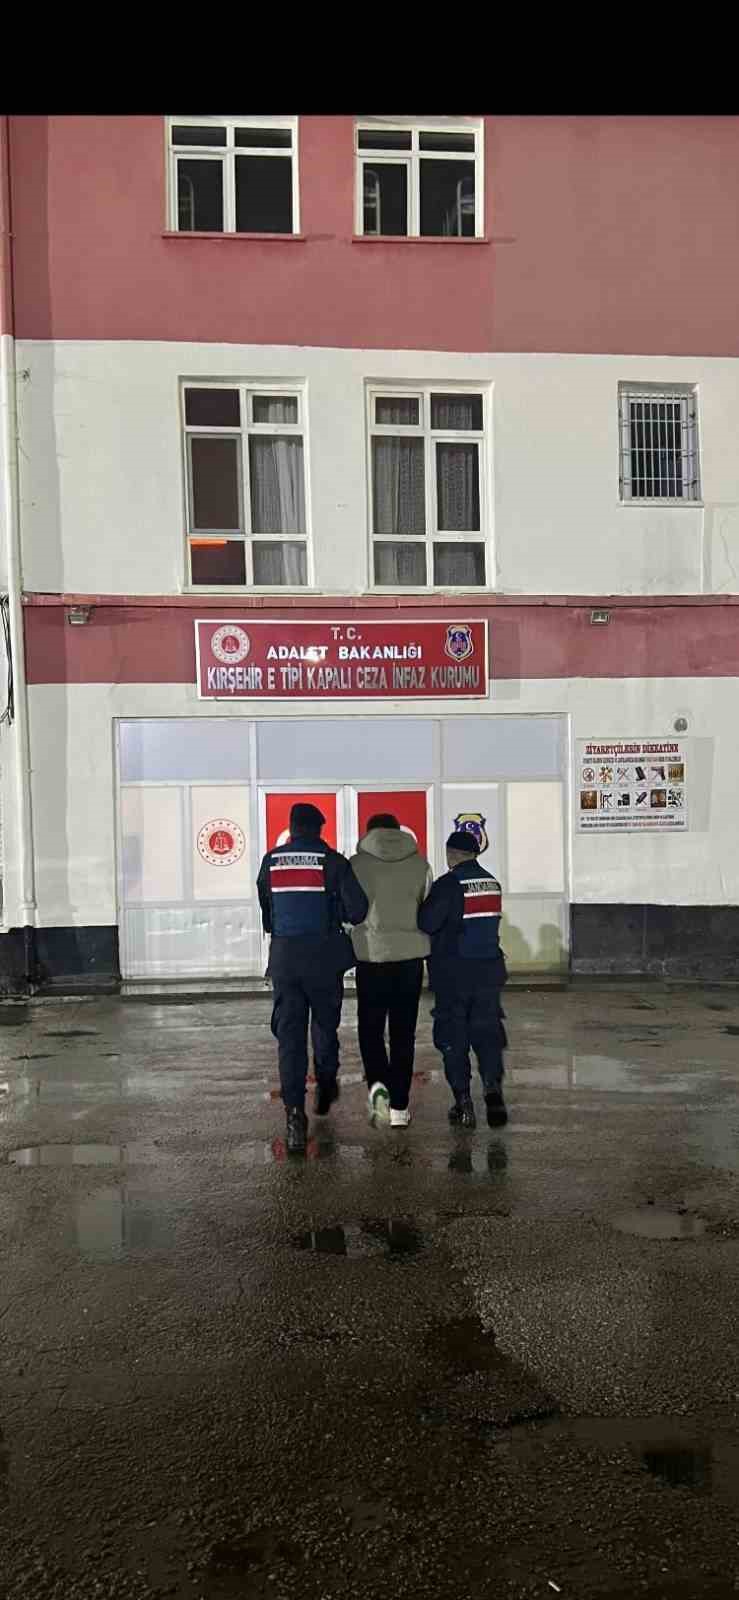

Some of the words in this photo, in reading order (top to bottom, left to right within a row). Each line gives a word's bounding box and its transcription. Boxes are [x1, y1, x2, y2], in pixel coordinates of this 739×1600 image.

[266, 645, 329, 661] ADALET
[339, 642, 422, 659] BAKANLIĞI
[207, 661, 263, 693] KIRŞEHİR
[268, 667, 275, 689] E
[281, 661, 303, 689] TİPİ
[307, 667, 352, 689] KAPALI
[356, 667, 388, 689] CEZA
[392, 661, 426, 689] İNFAZ
[431, 665, 480, 689] KURUMU
